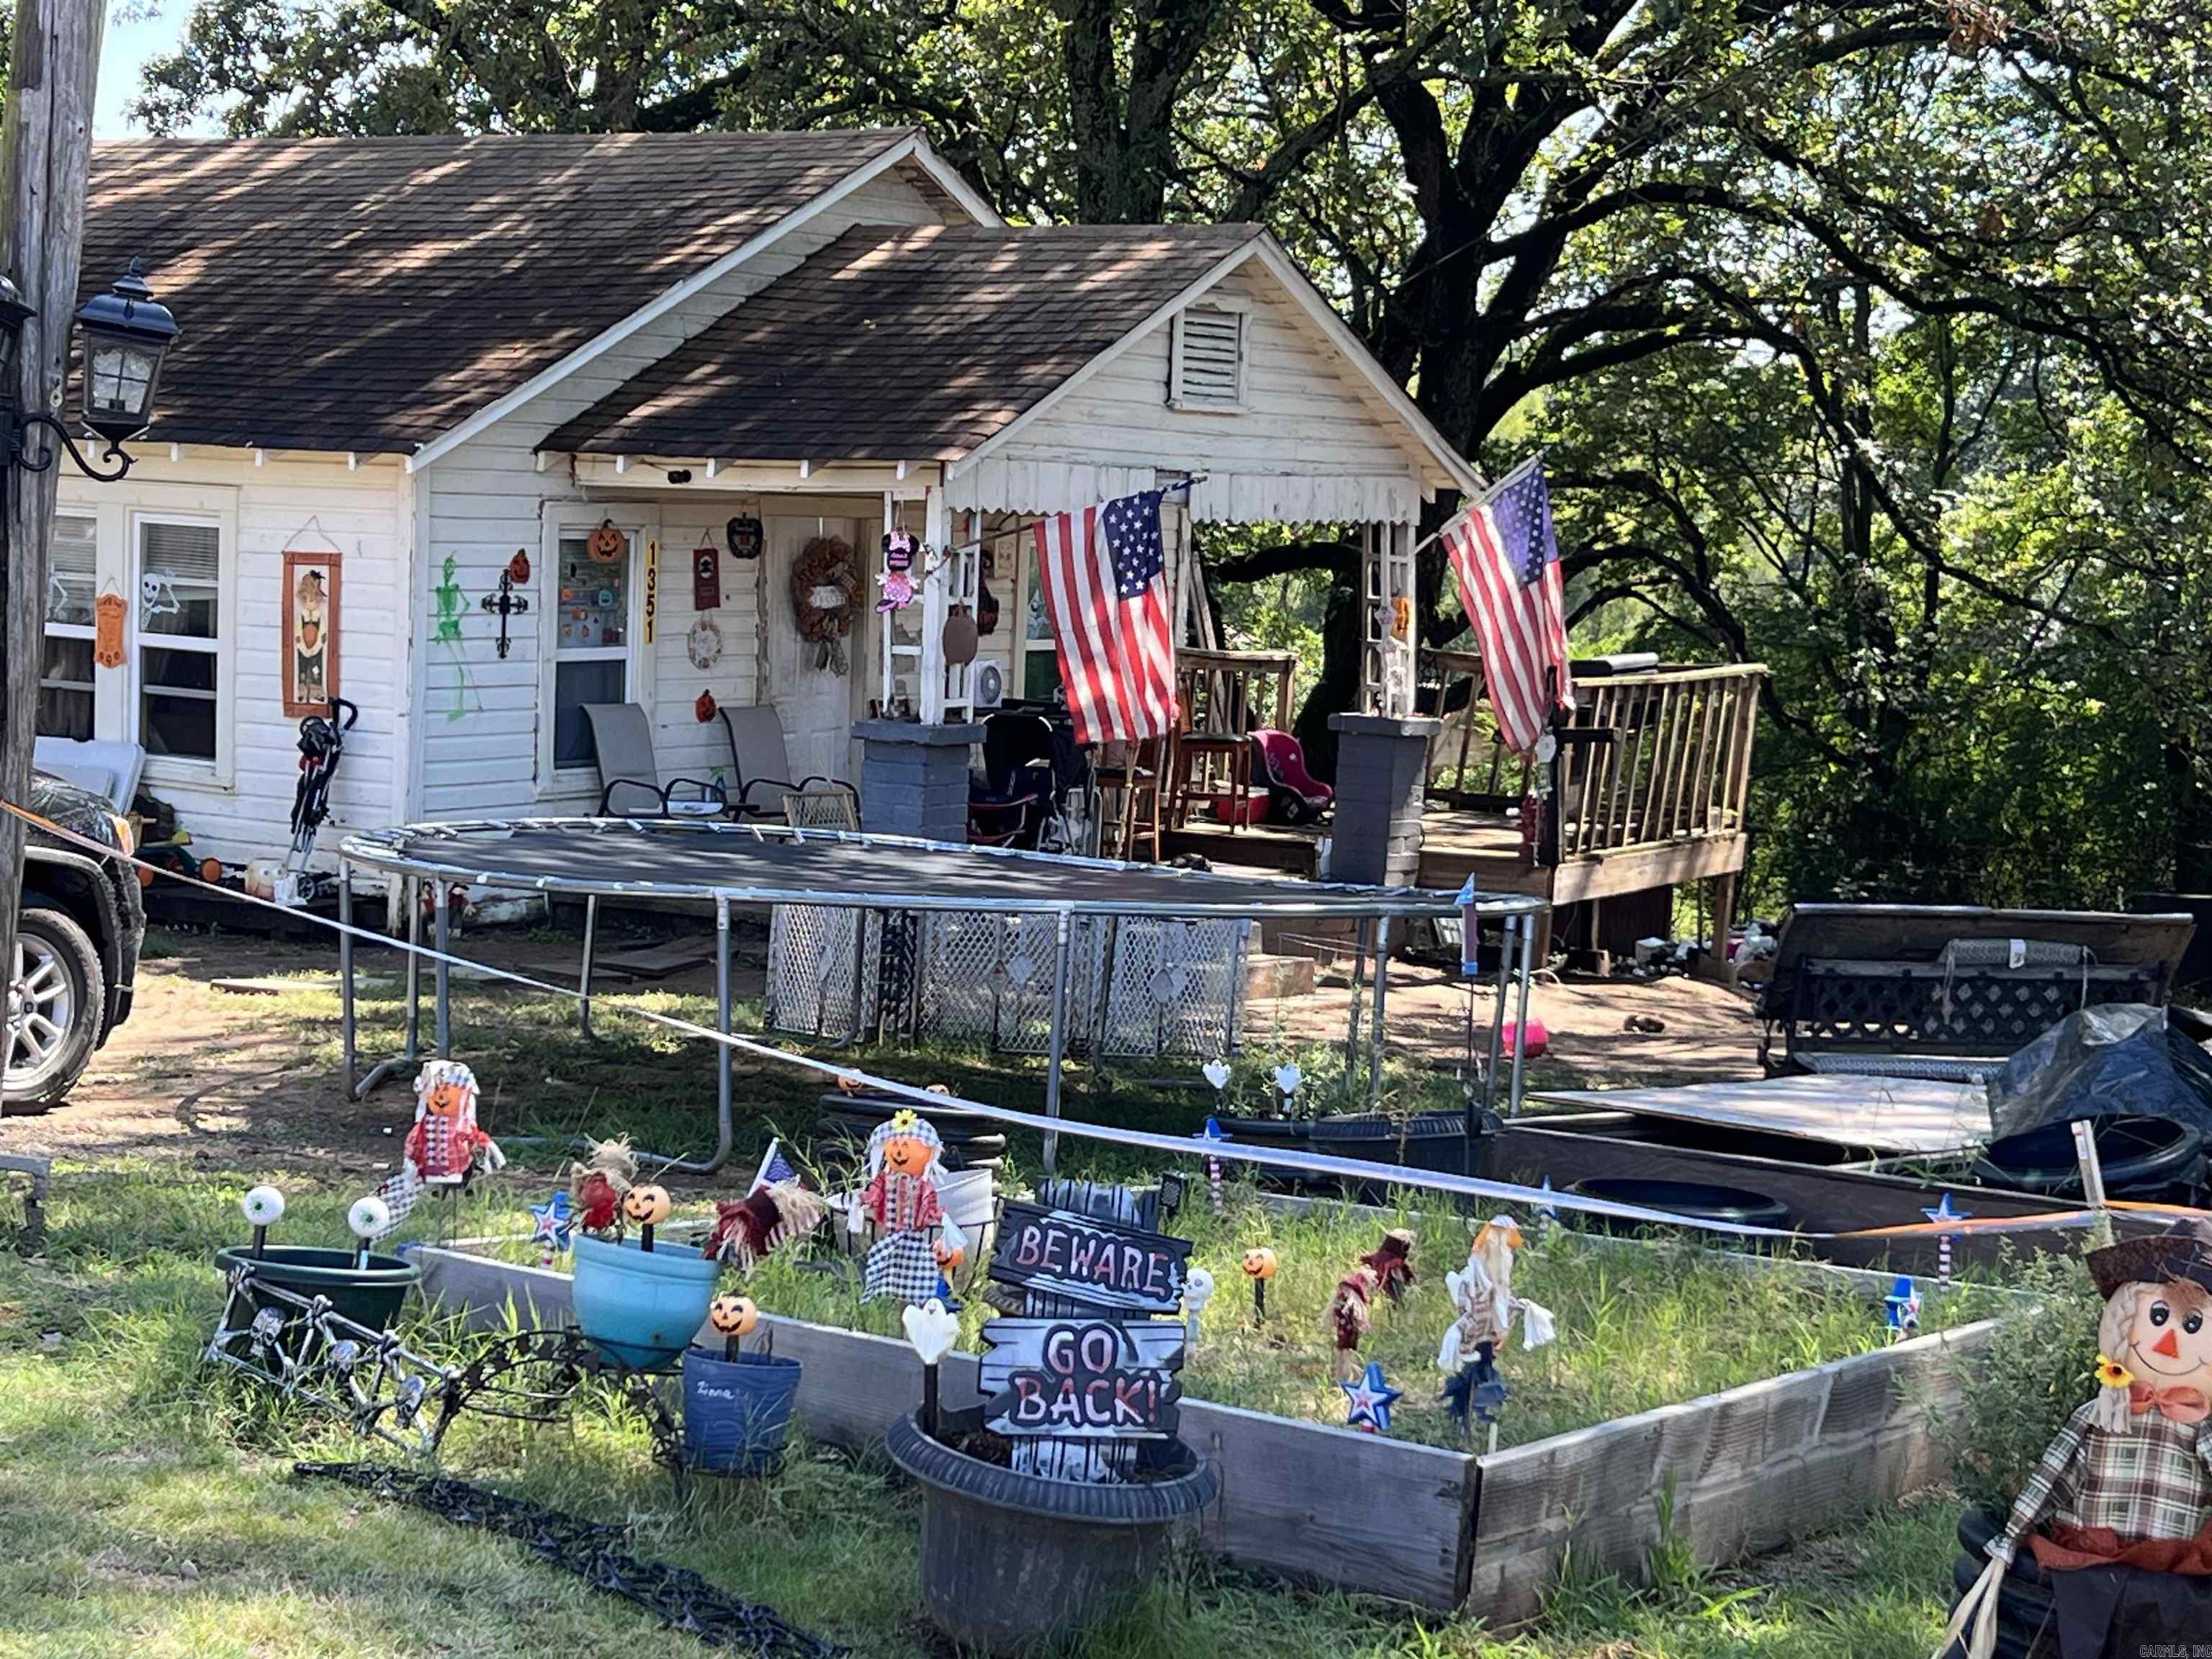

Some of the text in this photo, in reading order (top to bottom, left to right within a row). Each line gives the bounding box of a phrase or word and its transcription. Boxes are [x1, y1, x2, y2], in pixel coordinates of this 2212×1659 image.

[647, 541, 656, 643] 1351
[1016, 1226, 1169, 1295] BEWARE
[1047, 1328, 1114, 1373] GO
[1015, 1377, 1156, 1424] BACK!
